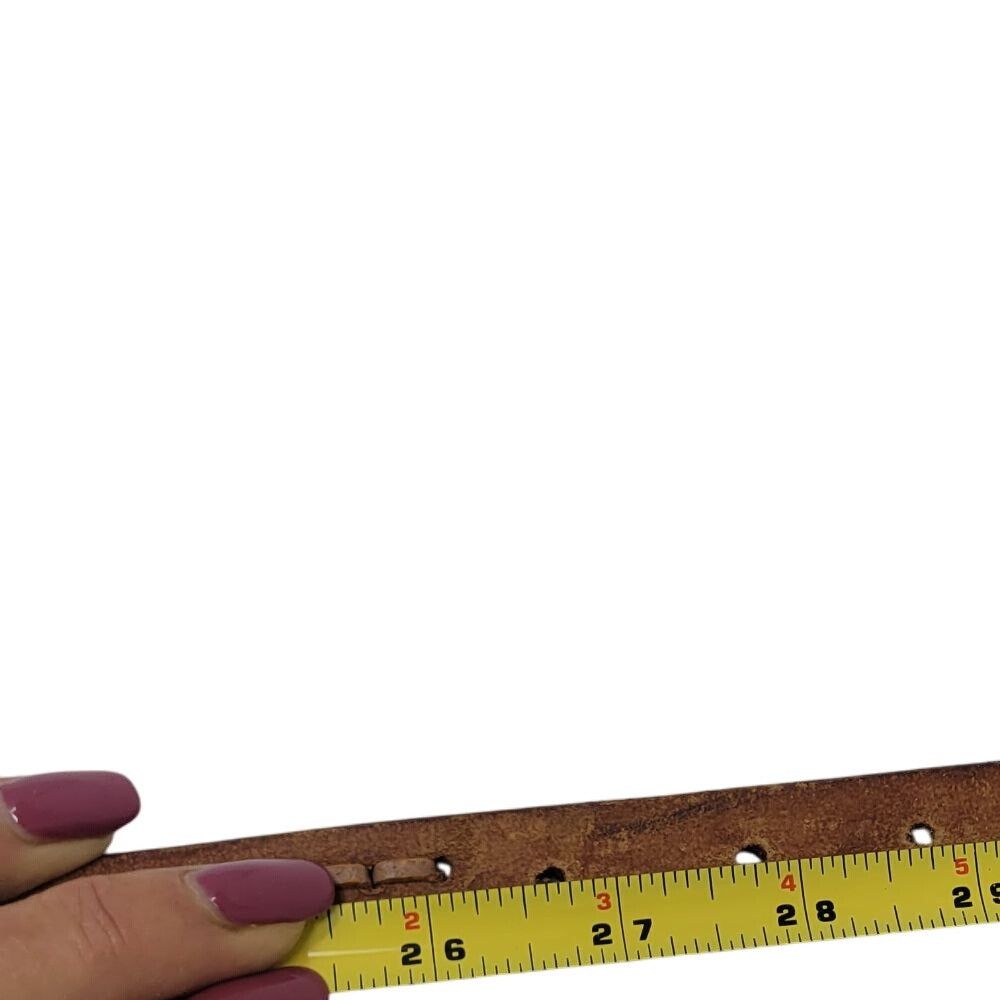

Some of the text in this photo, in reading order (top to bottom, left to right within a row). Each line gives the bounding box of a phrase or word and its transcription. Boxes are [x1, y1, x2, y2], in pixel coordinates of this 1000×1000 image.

[404, 912, 420, 930] 2
[596, 892, 612, 911] 3
[780, 874, 796, 892] 4
[954, 857, 970, 876] 5
